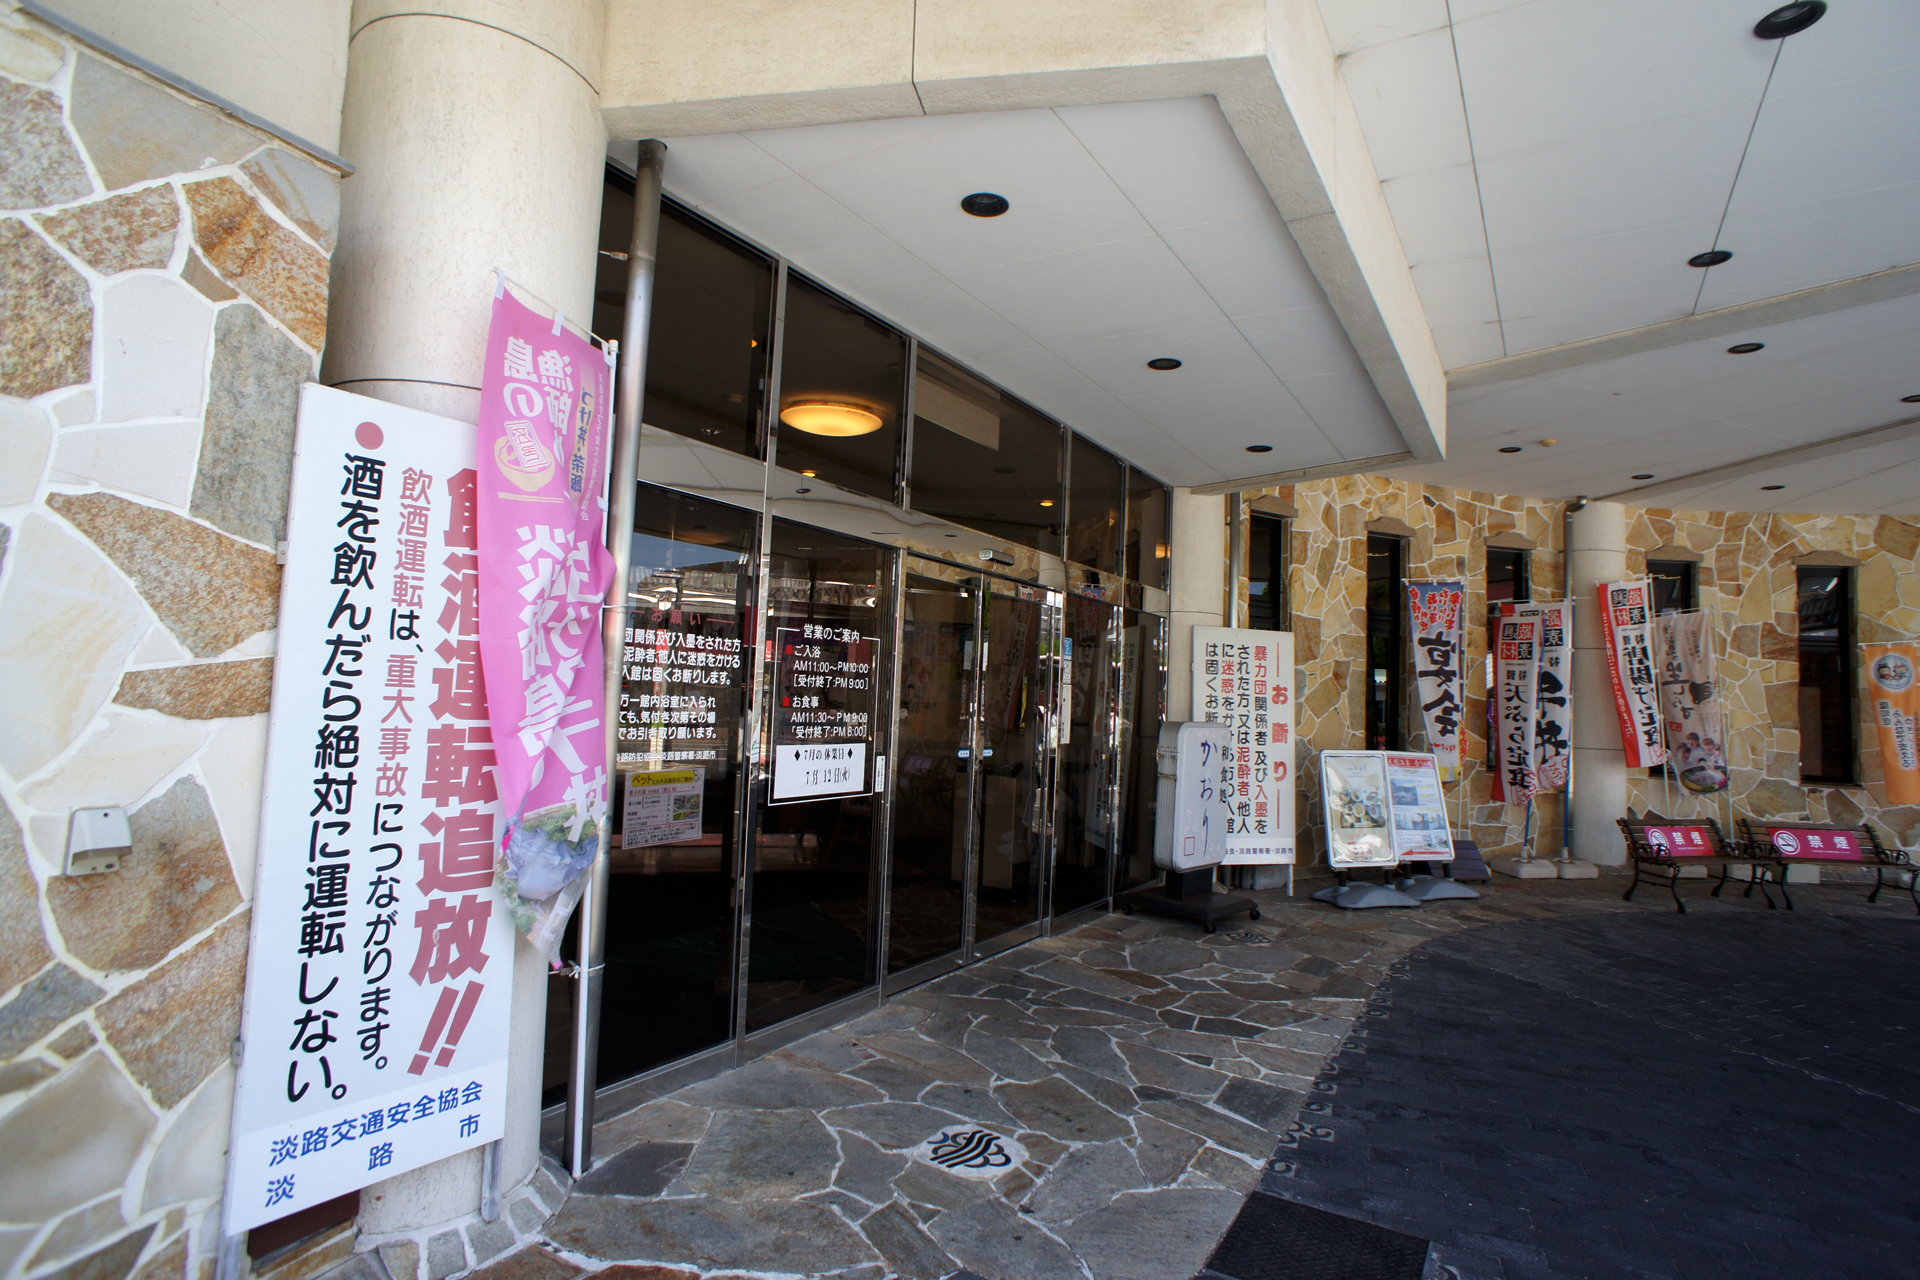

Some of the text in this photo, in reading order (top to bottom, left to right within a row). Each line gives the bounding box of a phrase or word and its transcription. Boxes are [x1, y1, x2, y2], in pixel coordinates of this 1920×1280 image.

[650, 608, 702, 626] お願い
[803, 623, 860, 644] 営業のご案内
[623, 645, 742, 669] 泥酔者、他人に迷惑をかける
[794, 644, 821, 658] ご入浴
[619, 695, 716, 709] 万一館内浴室に入られ
[792, 695, 820, 709] お食事
[618, 710, 716, 725] ても、気付き次第その場
[617, 726, 717, 741] でお引き取り願います。
[1236, 644, 1251, 834] された方、又は泥酔者、他人
[1254, 645, 1268, 835] 暴力団関係者及び入墨を
[1271, 684, 1289, 782] お断り
[286, 451, 387, 1103] 酒を飲んだら絶対に運転しない。
[357, 466, 434, 1071] 飲酒運転は、重大事故につながります。
[1218, 745, 1229, 804] 和食処
[1200, 739, 1218, 858] かおり
[1671, 832, 1704, 845] 禁煙
[1806, 834, 1851, 849] 禁煙
[269, 1080, 483, 1168] 淡路交通安全協会
[264, 1113, 480, 1208] 淡路市
